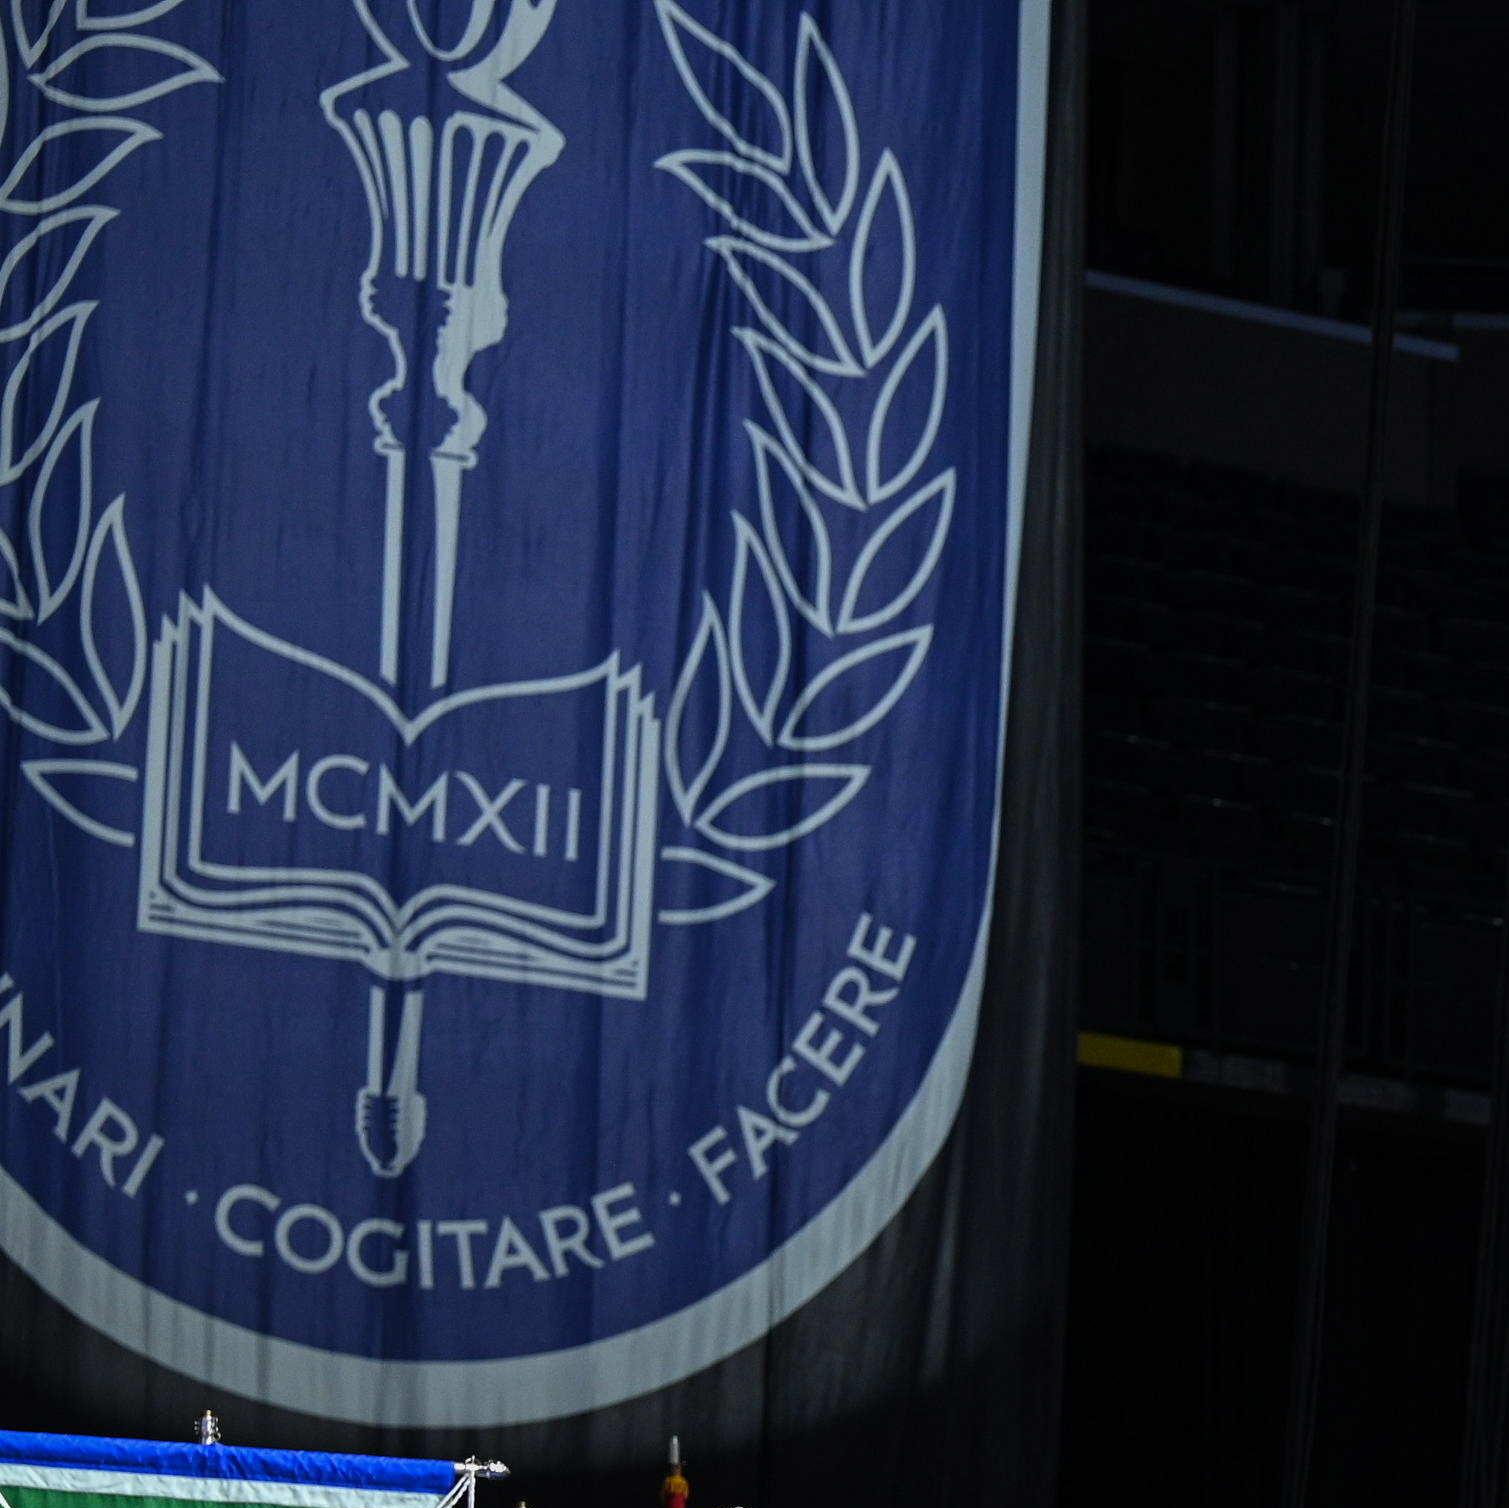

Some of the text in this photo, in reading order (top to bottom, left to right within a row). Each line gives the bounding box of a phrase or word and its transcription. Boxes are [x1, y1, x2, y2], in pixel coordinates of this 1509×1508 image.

[227, 741, 582, 861] MCMXII
[0, 911, 918, 1290] NARI COGITARE FACERE
